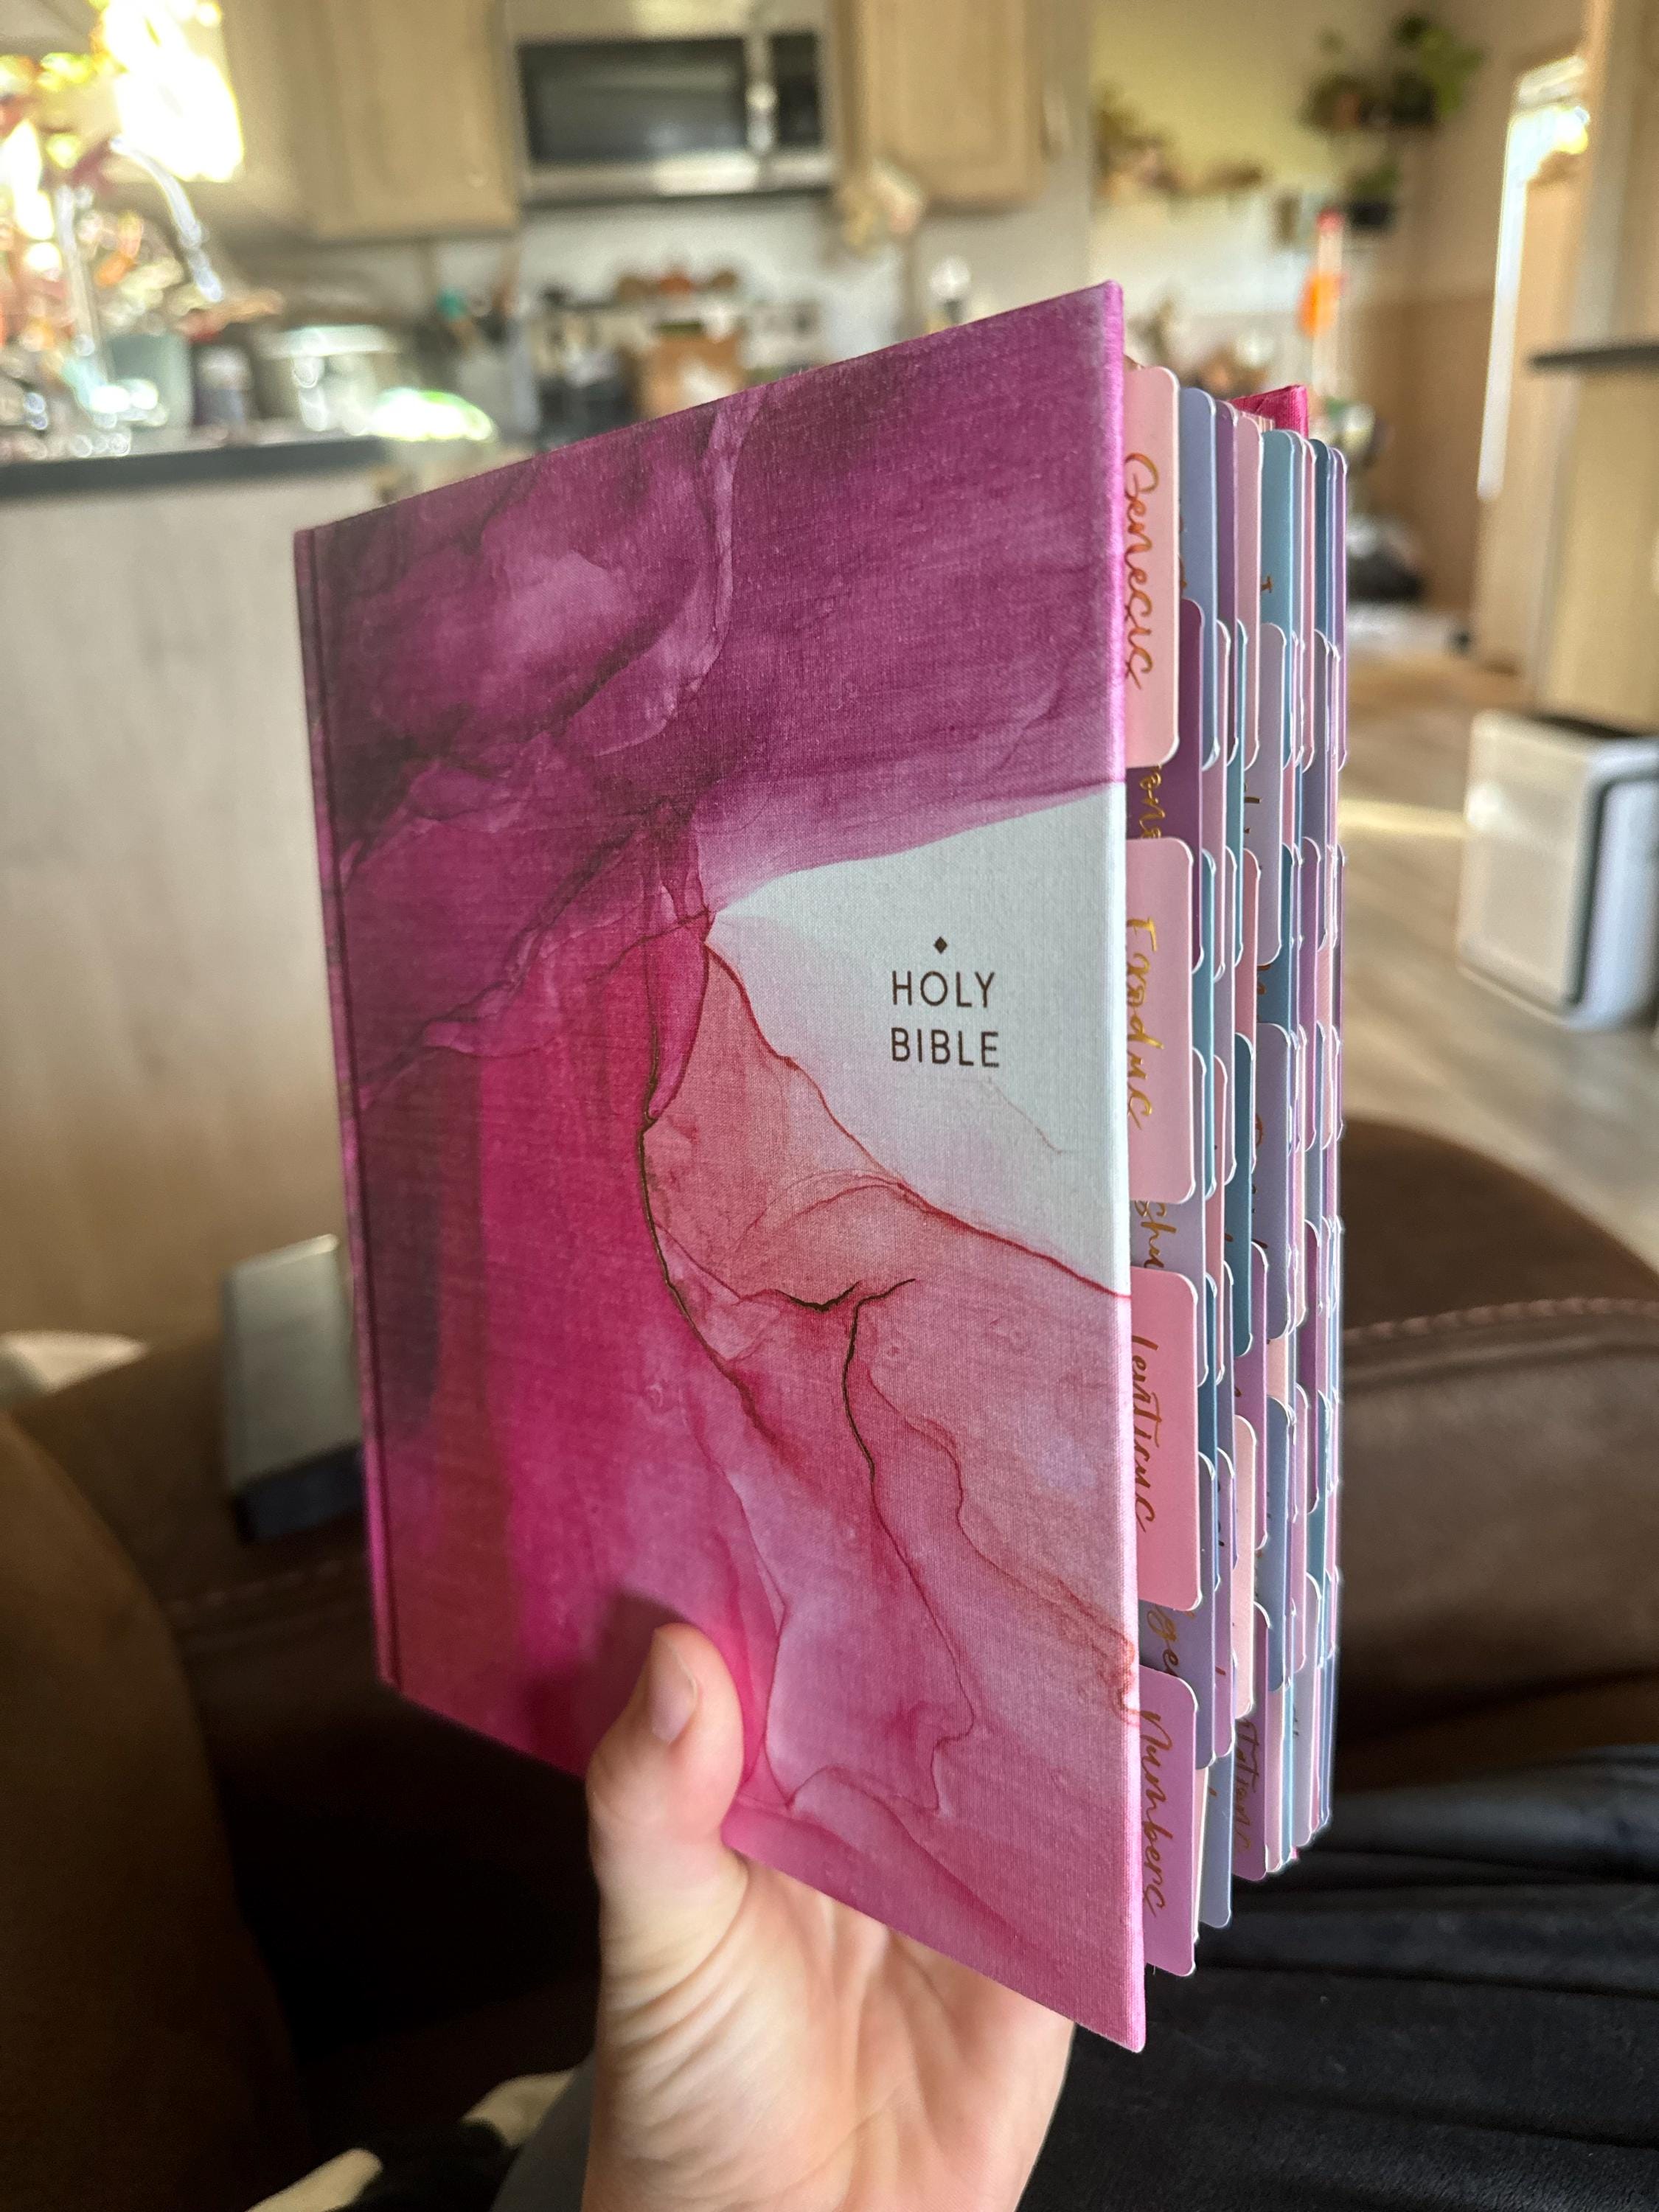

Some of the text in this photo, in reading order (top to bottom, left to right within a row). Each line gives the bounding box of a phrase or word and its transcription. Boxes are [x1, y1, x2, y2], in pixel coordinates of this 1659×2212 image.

[1125, 453, 1160, 690] Genesis
[891, 1027, 999, 1068] BIBLE
[892, 970, 995, 1008] HOLY
[1127, 917, 1164, 1130] Exodus
[1140, 1708, 1173, 1917] Numbers
